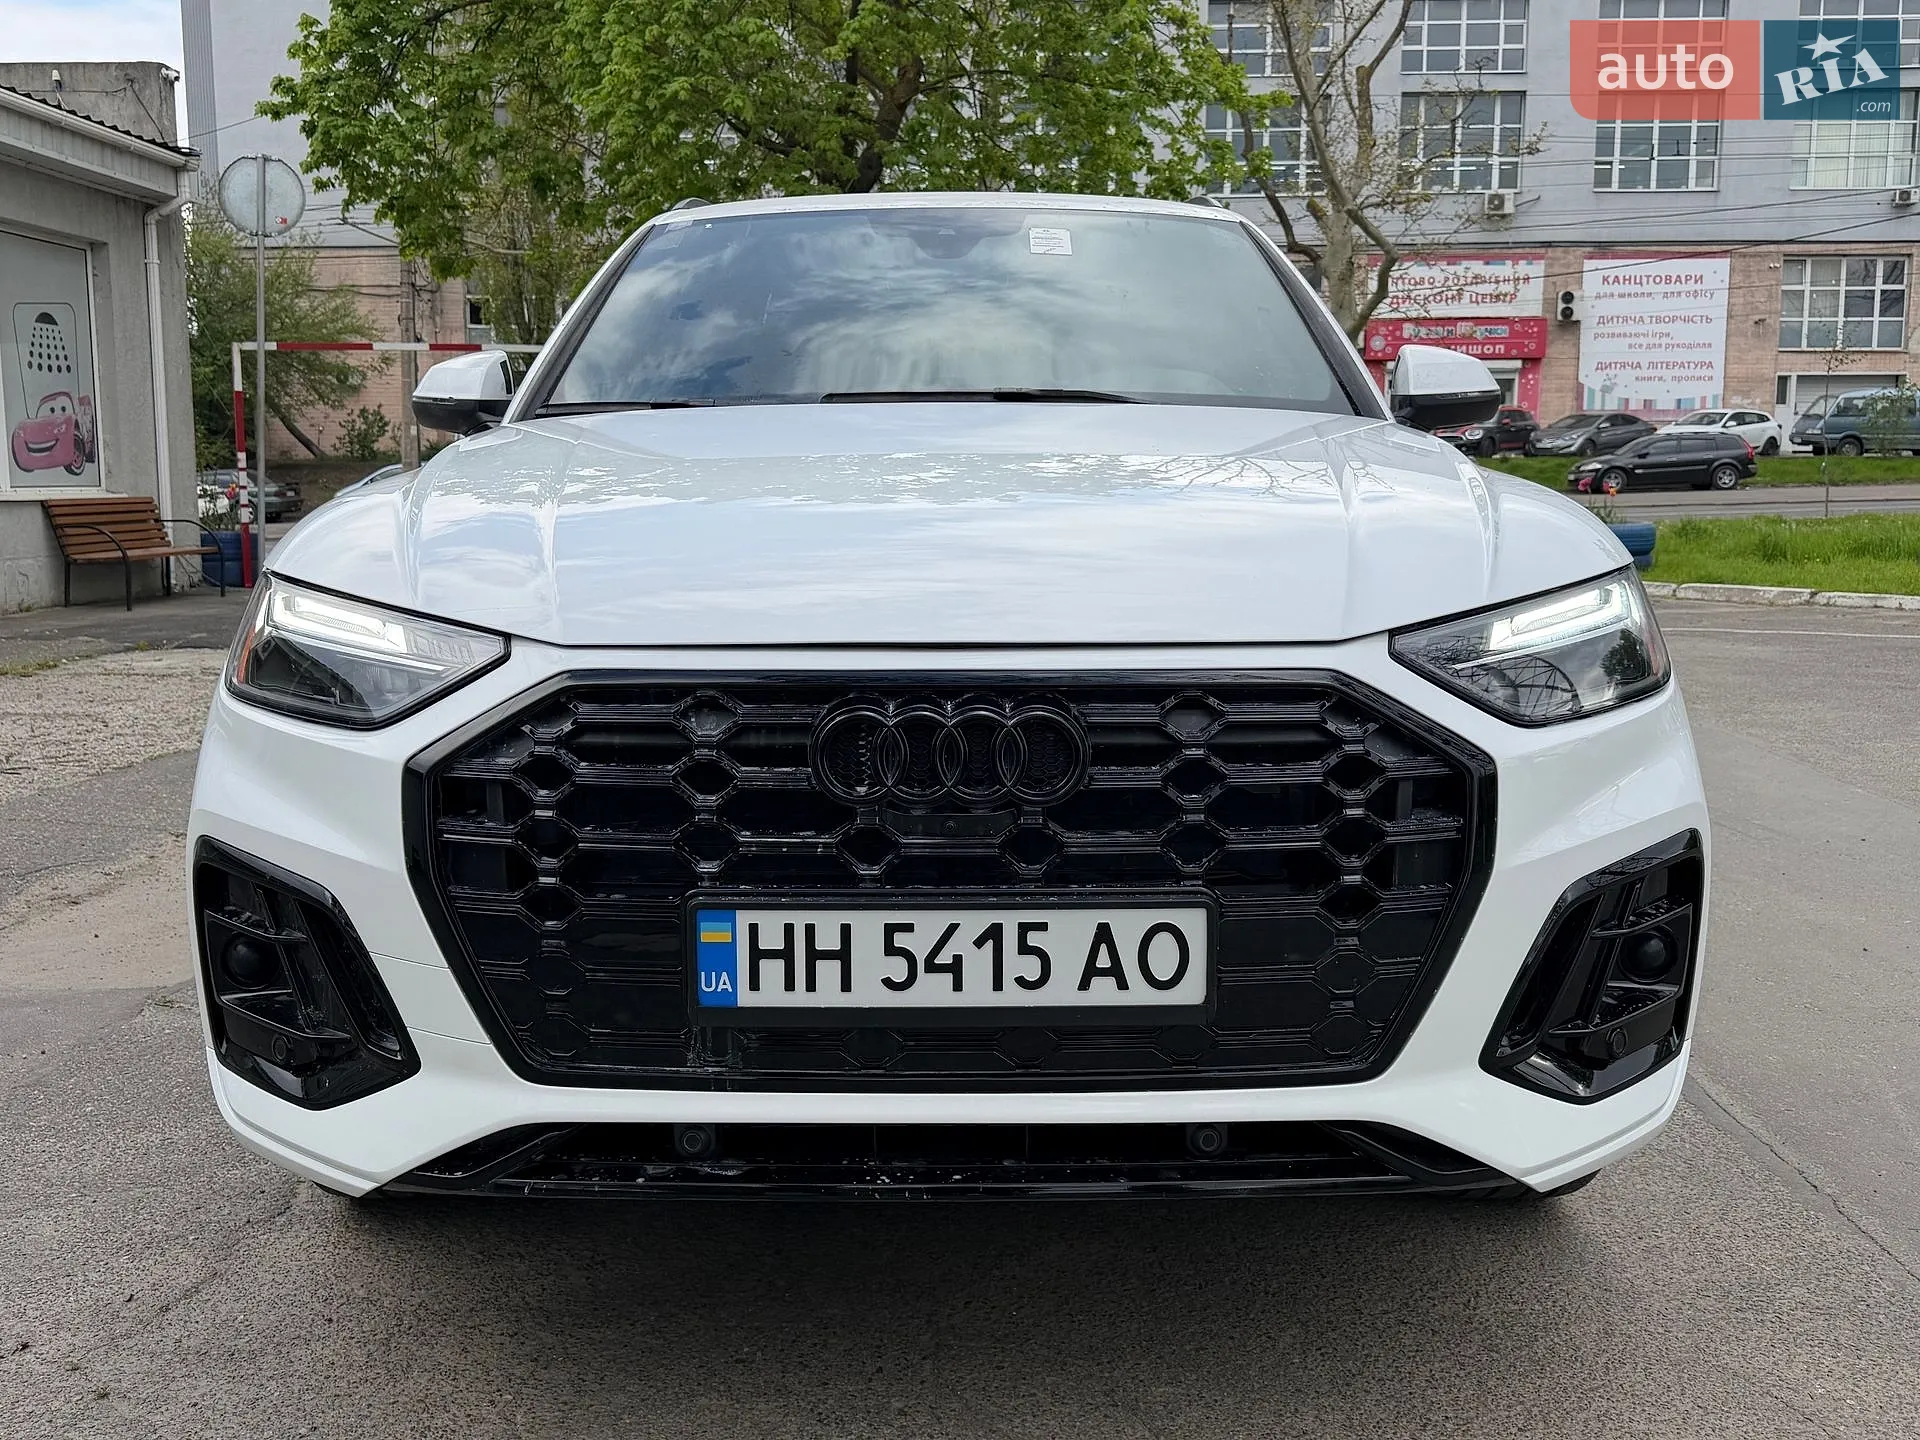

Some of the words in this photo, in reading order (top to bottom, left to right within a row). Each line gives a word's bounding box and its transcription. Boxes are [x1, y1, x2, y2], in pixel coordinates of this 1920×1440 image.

[1602, 274, 1704, 287] КАНЦТОВАРИ
[1594, 291, 1614, 300] для
[1662, 291, 1682, 300] для
[1597, 315, 1645, 326] ДИТЯЧА
[1648, 315, 1713, 325] ТВОРЧІСТЬ
[1593, 330, 1650, 340] розвиваючі
[1665, 341, 1712, 351] рукоділля
[1595, 361, 1642, 372] ДИТЯЧА
[1646, 360, 1714, 370] ЛІТЕРАТУРА
[1671, 375, 1713, 384] прописи
[748, 922, 853, 993] HH
[880, 922, 1052, 993] 5415
[1076, 921, 1191, 993] AO
[700, 971, 733, 993] UA
